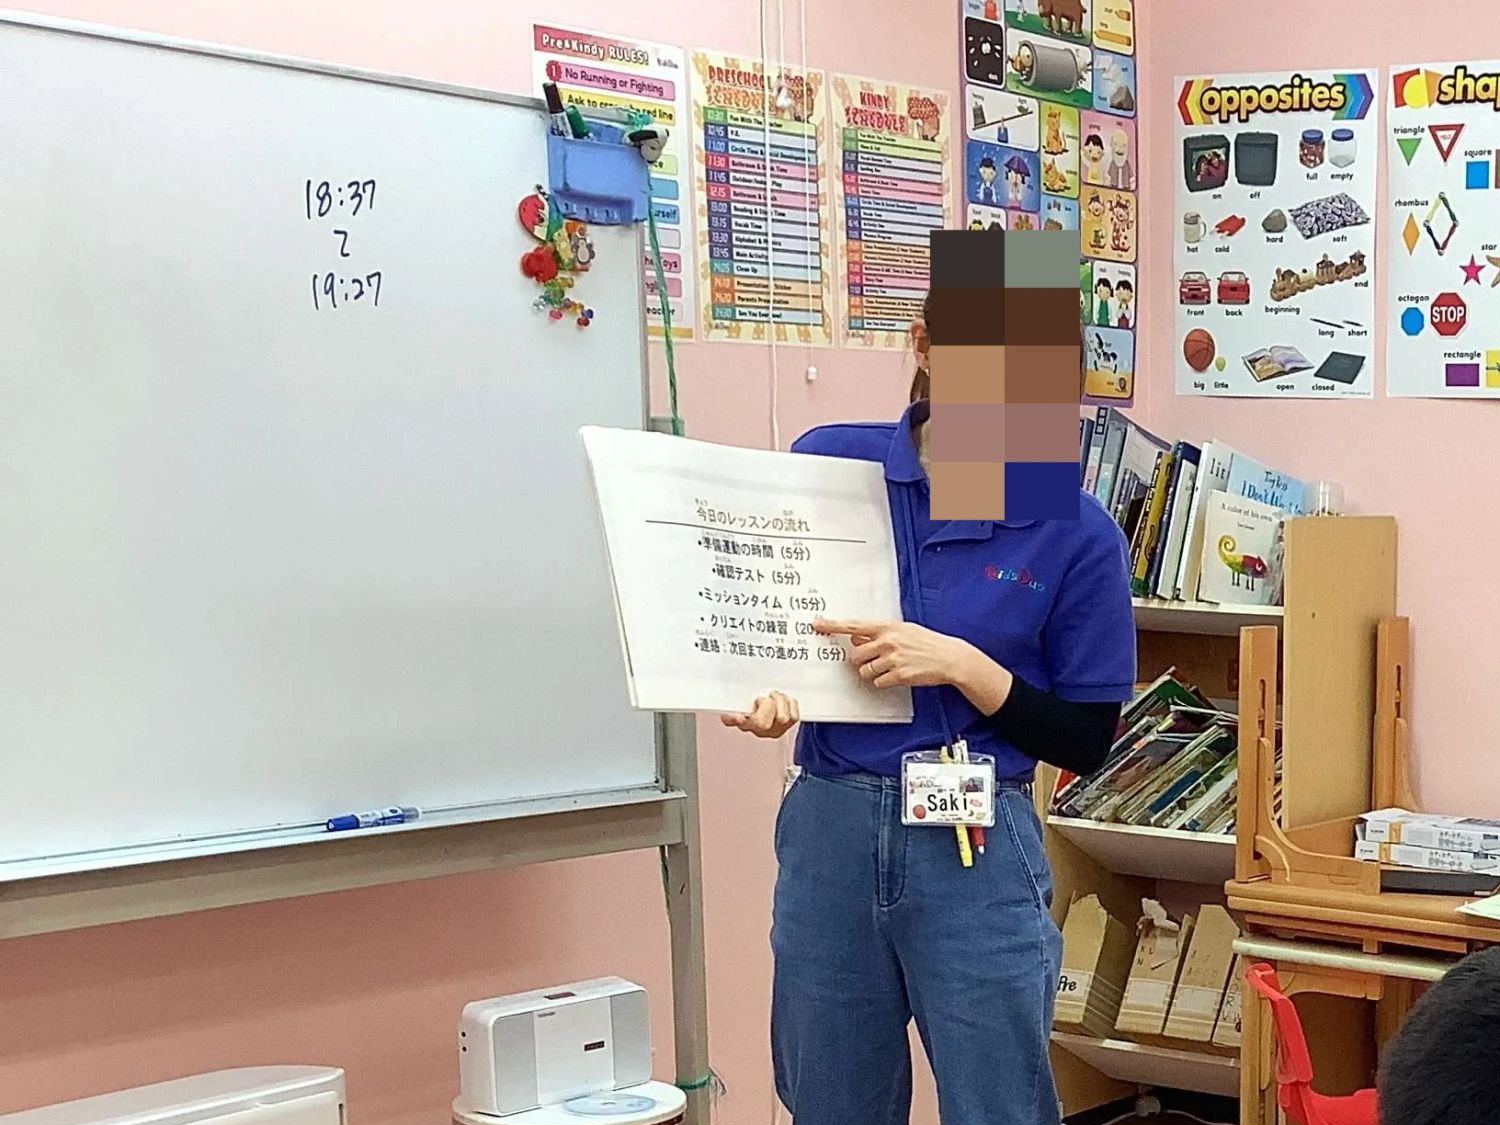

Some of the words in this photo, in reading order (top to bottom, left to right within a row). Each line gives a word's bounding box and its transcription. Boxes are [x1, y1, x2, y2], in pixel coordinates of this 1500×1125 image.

[609, 45, 649, 65] RULES!
[551, 65, 557, 76] 1
[565, 68, 578, 79] No
[580, 70, 617, 88] Running
[619, 78, 628, 87] or
[630, 79, 663, 96] Fighting
[1200, 73, 1347, 123] opposites
[568, 95, 582, 106] Ask
[588, 97, 597, 107] to
[659, 108, 673, 121] line
[1393, 126, 1425, 136] triangle
[1463, 149, 1493, 158] square
[1306, 172, 1318, 181] full
[1330, 172, 1353, 182] empty
[306, 179, 376, 220] 18:37
[1250, 191, 1261, 199] off
[1394, 199, 1429, 208] rhombus
[1266, 235, 1283, 243] hard
[1332, 235, 1347, 243] soft
[1215, 245, 1230, 253] cold
[1481, 243, 1497, 251] star
[313, 272, 381, 310] 19:27
[1397, 294, 1430, 303] octagon
[1225, 309, 1243, 317] back
[1265, 306, 1301, 315] beginning
[1432, 306, 1465, 323] STOP
[1318, 329, 1335, 338] long
[1348, 329, 1367, 337] short
[1443, 351, 1482, 360] rectangle
[1193, 382, 1205, 391] big
[1276, 383, 1294, 391] open
[1311, 383, 1335, 391] closed
[1210, 458, 1230, 480] lit
[696, 506, 810, 532] 今日のレッスンの流れ
[927, 792, 967, 811] Saki
